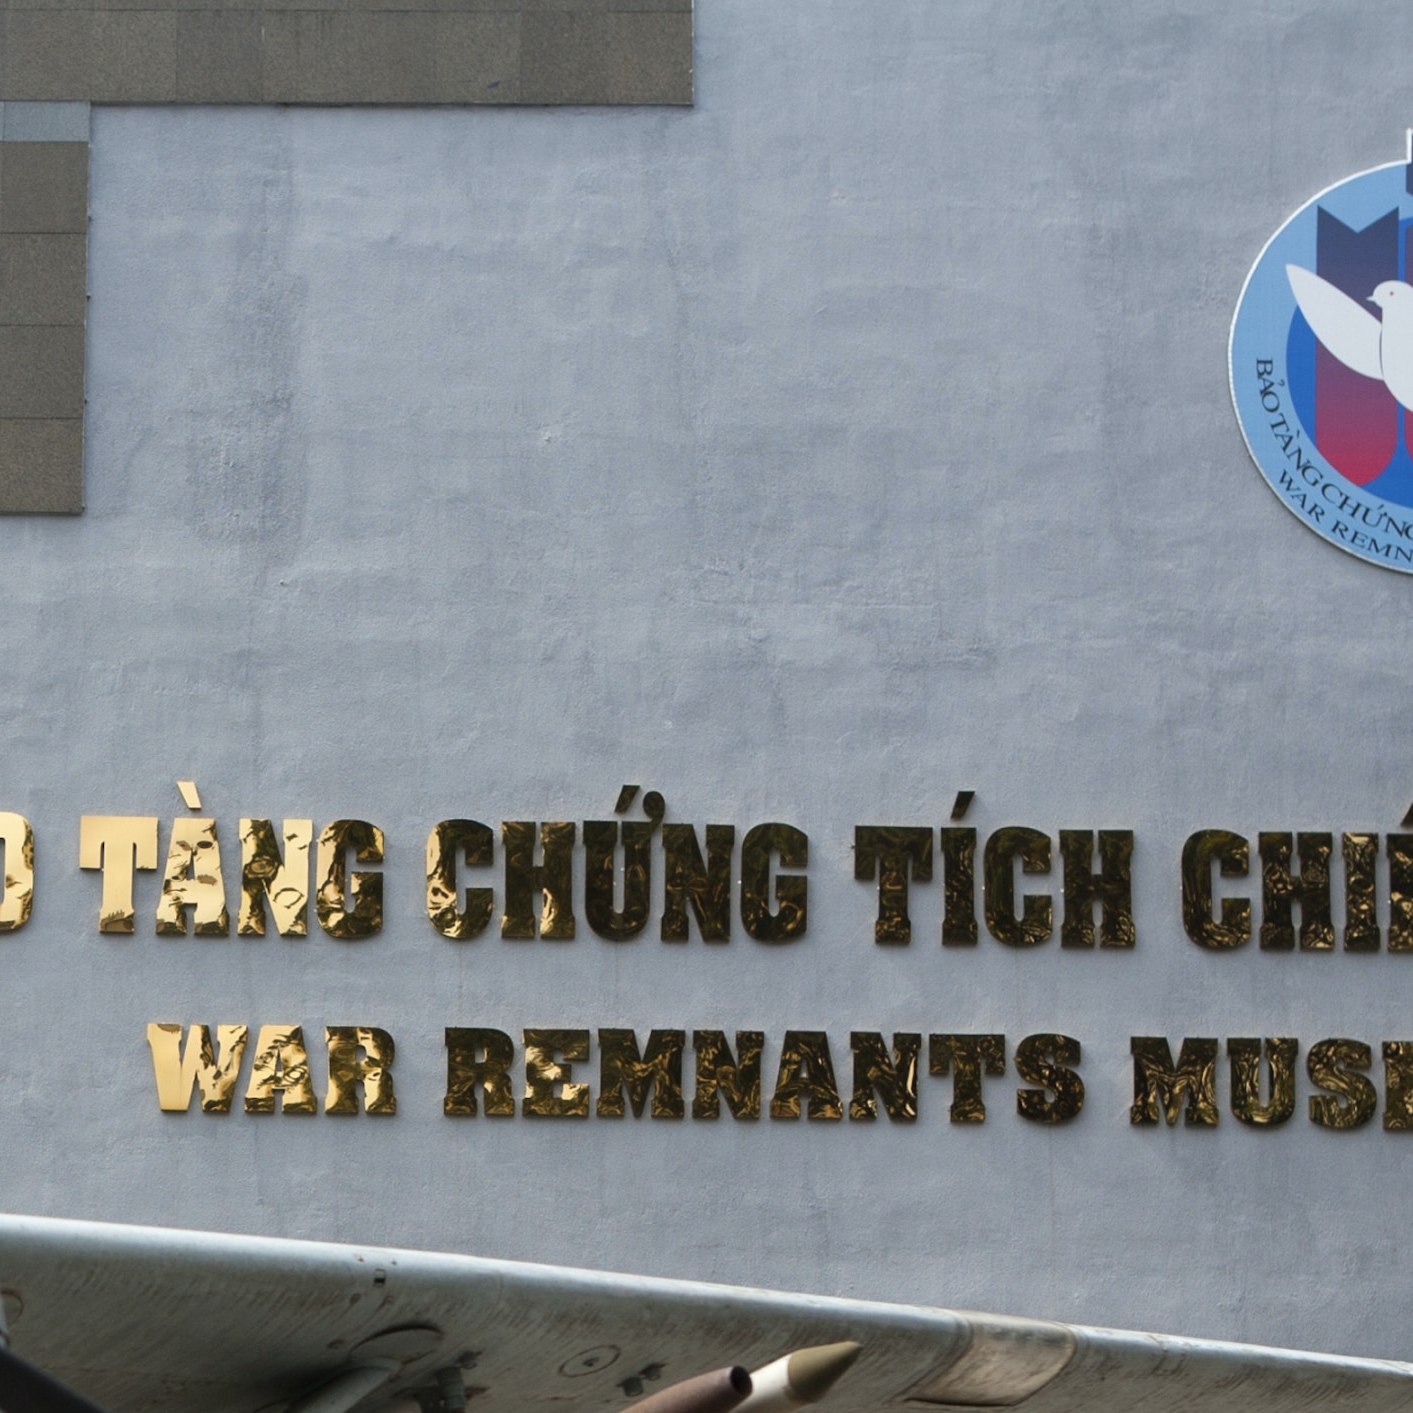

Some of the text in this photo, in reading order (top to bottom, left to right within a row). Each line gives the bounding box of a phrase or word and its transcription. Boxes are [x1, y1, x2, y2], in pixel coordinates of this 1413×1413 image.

[1278, 468, 1326, 524] WAR
[79, 780, 386, 939] TÀNG
[425, 784, 809, 944] CHỨNG
[853, 790, 1137, 949] TÍCH
[146, 1022, 397, 1116] WAR
[443, 1027, 1085, 1124] REMNANTS
